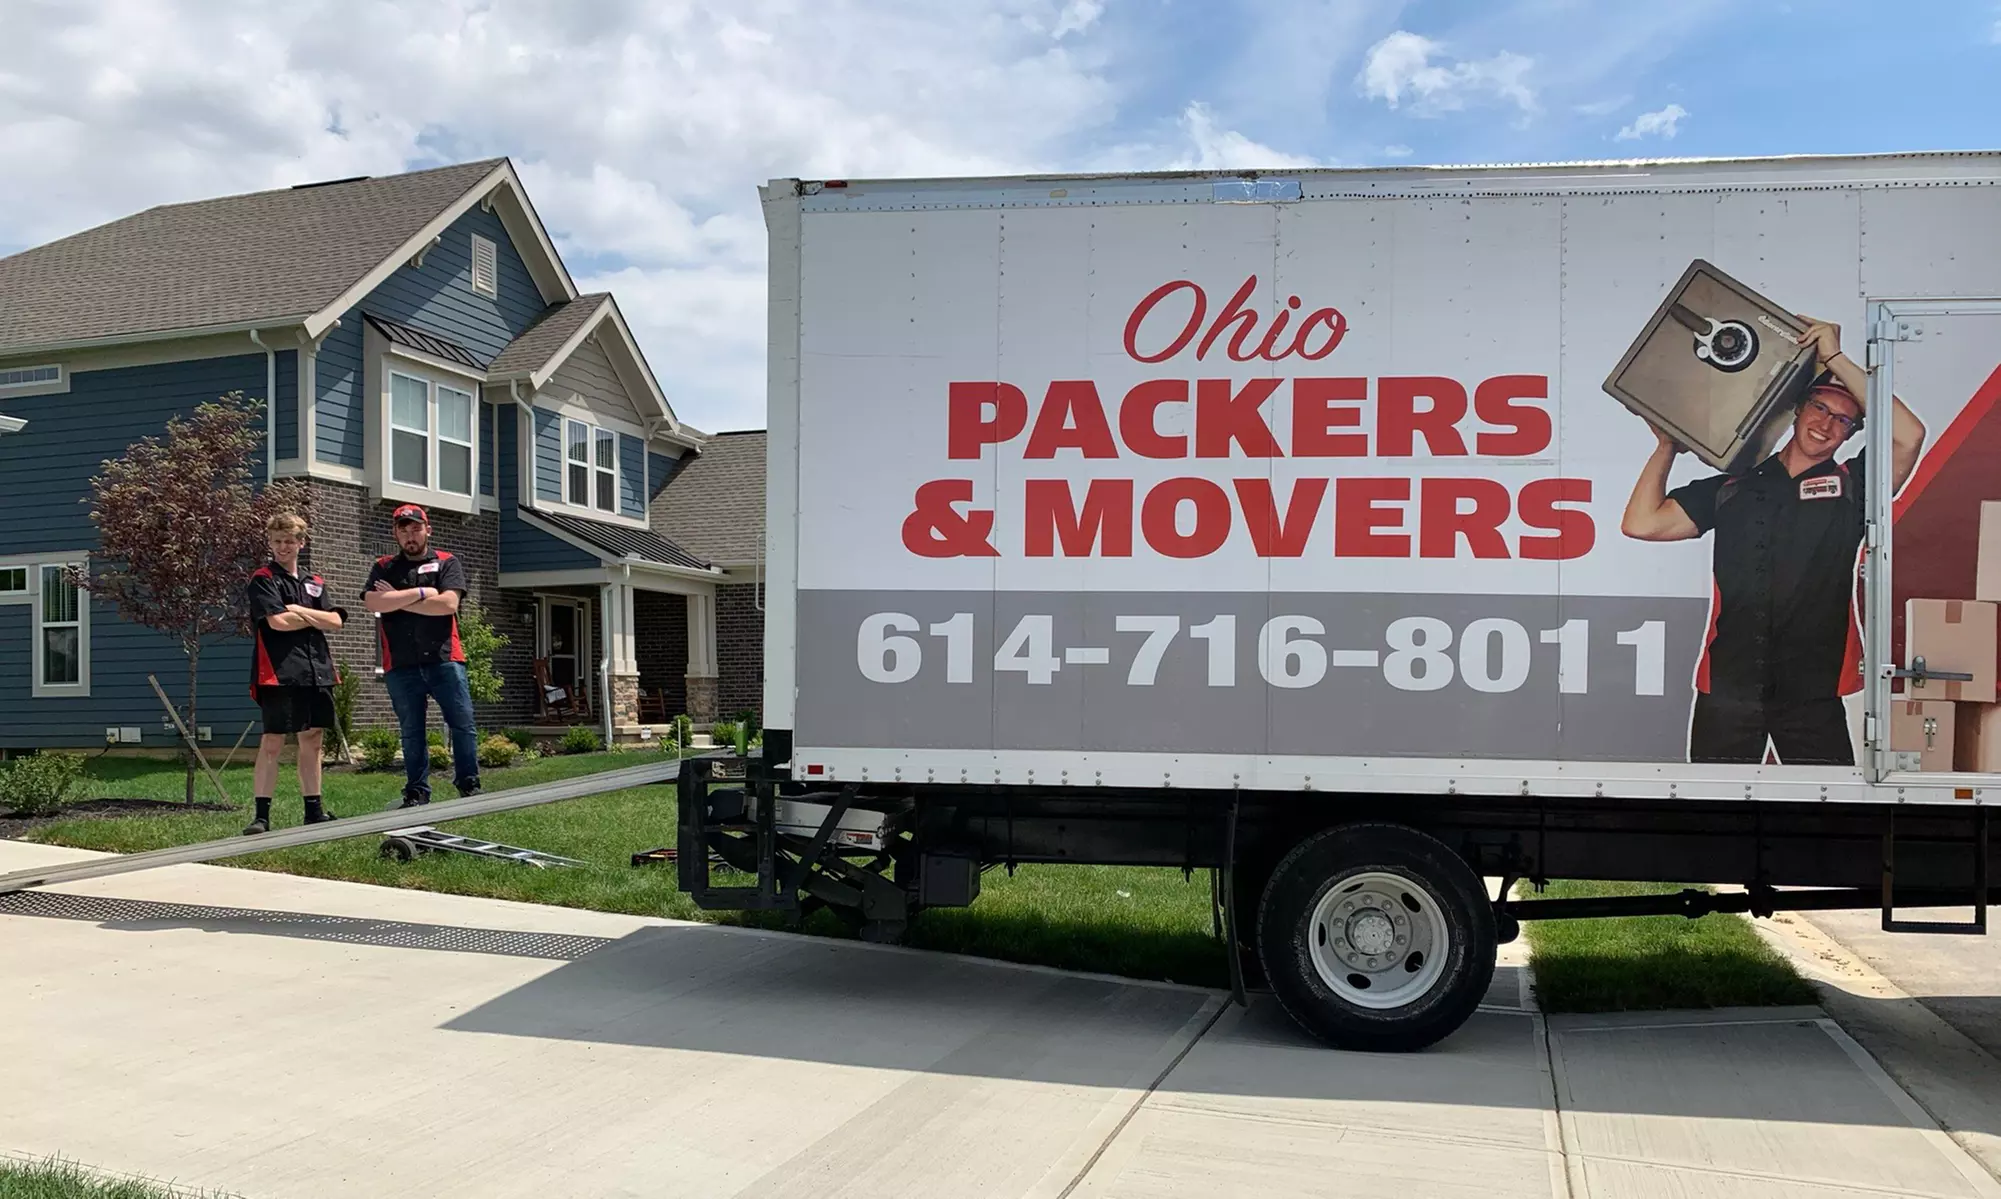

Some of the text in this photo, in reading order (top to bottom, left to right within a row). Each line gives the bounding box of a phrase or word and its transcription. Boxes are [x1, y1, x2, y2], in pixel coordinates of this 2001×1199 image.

[1124, 275, 1349, 362] Ohio
[947, 375, 1552, 460] PACKERS
[902, 477, 1596, 560] & MOVERS
[857, 612, 1667, 697] 614-716-8011
